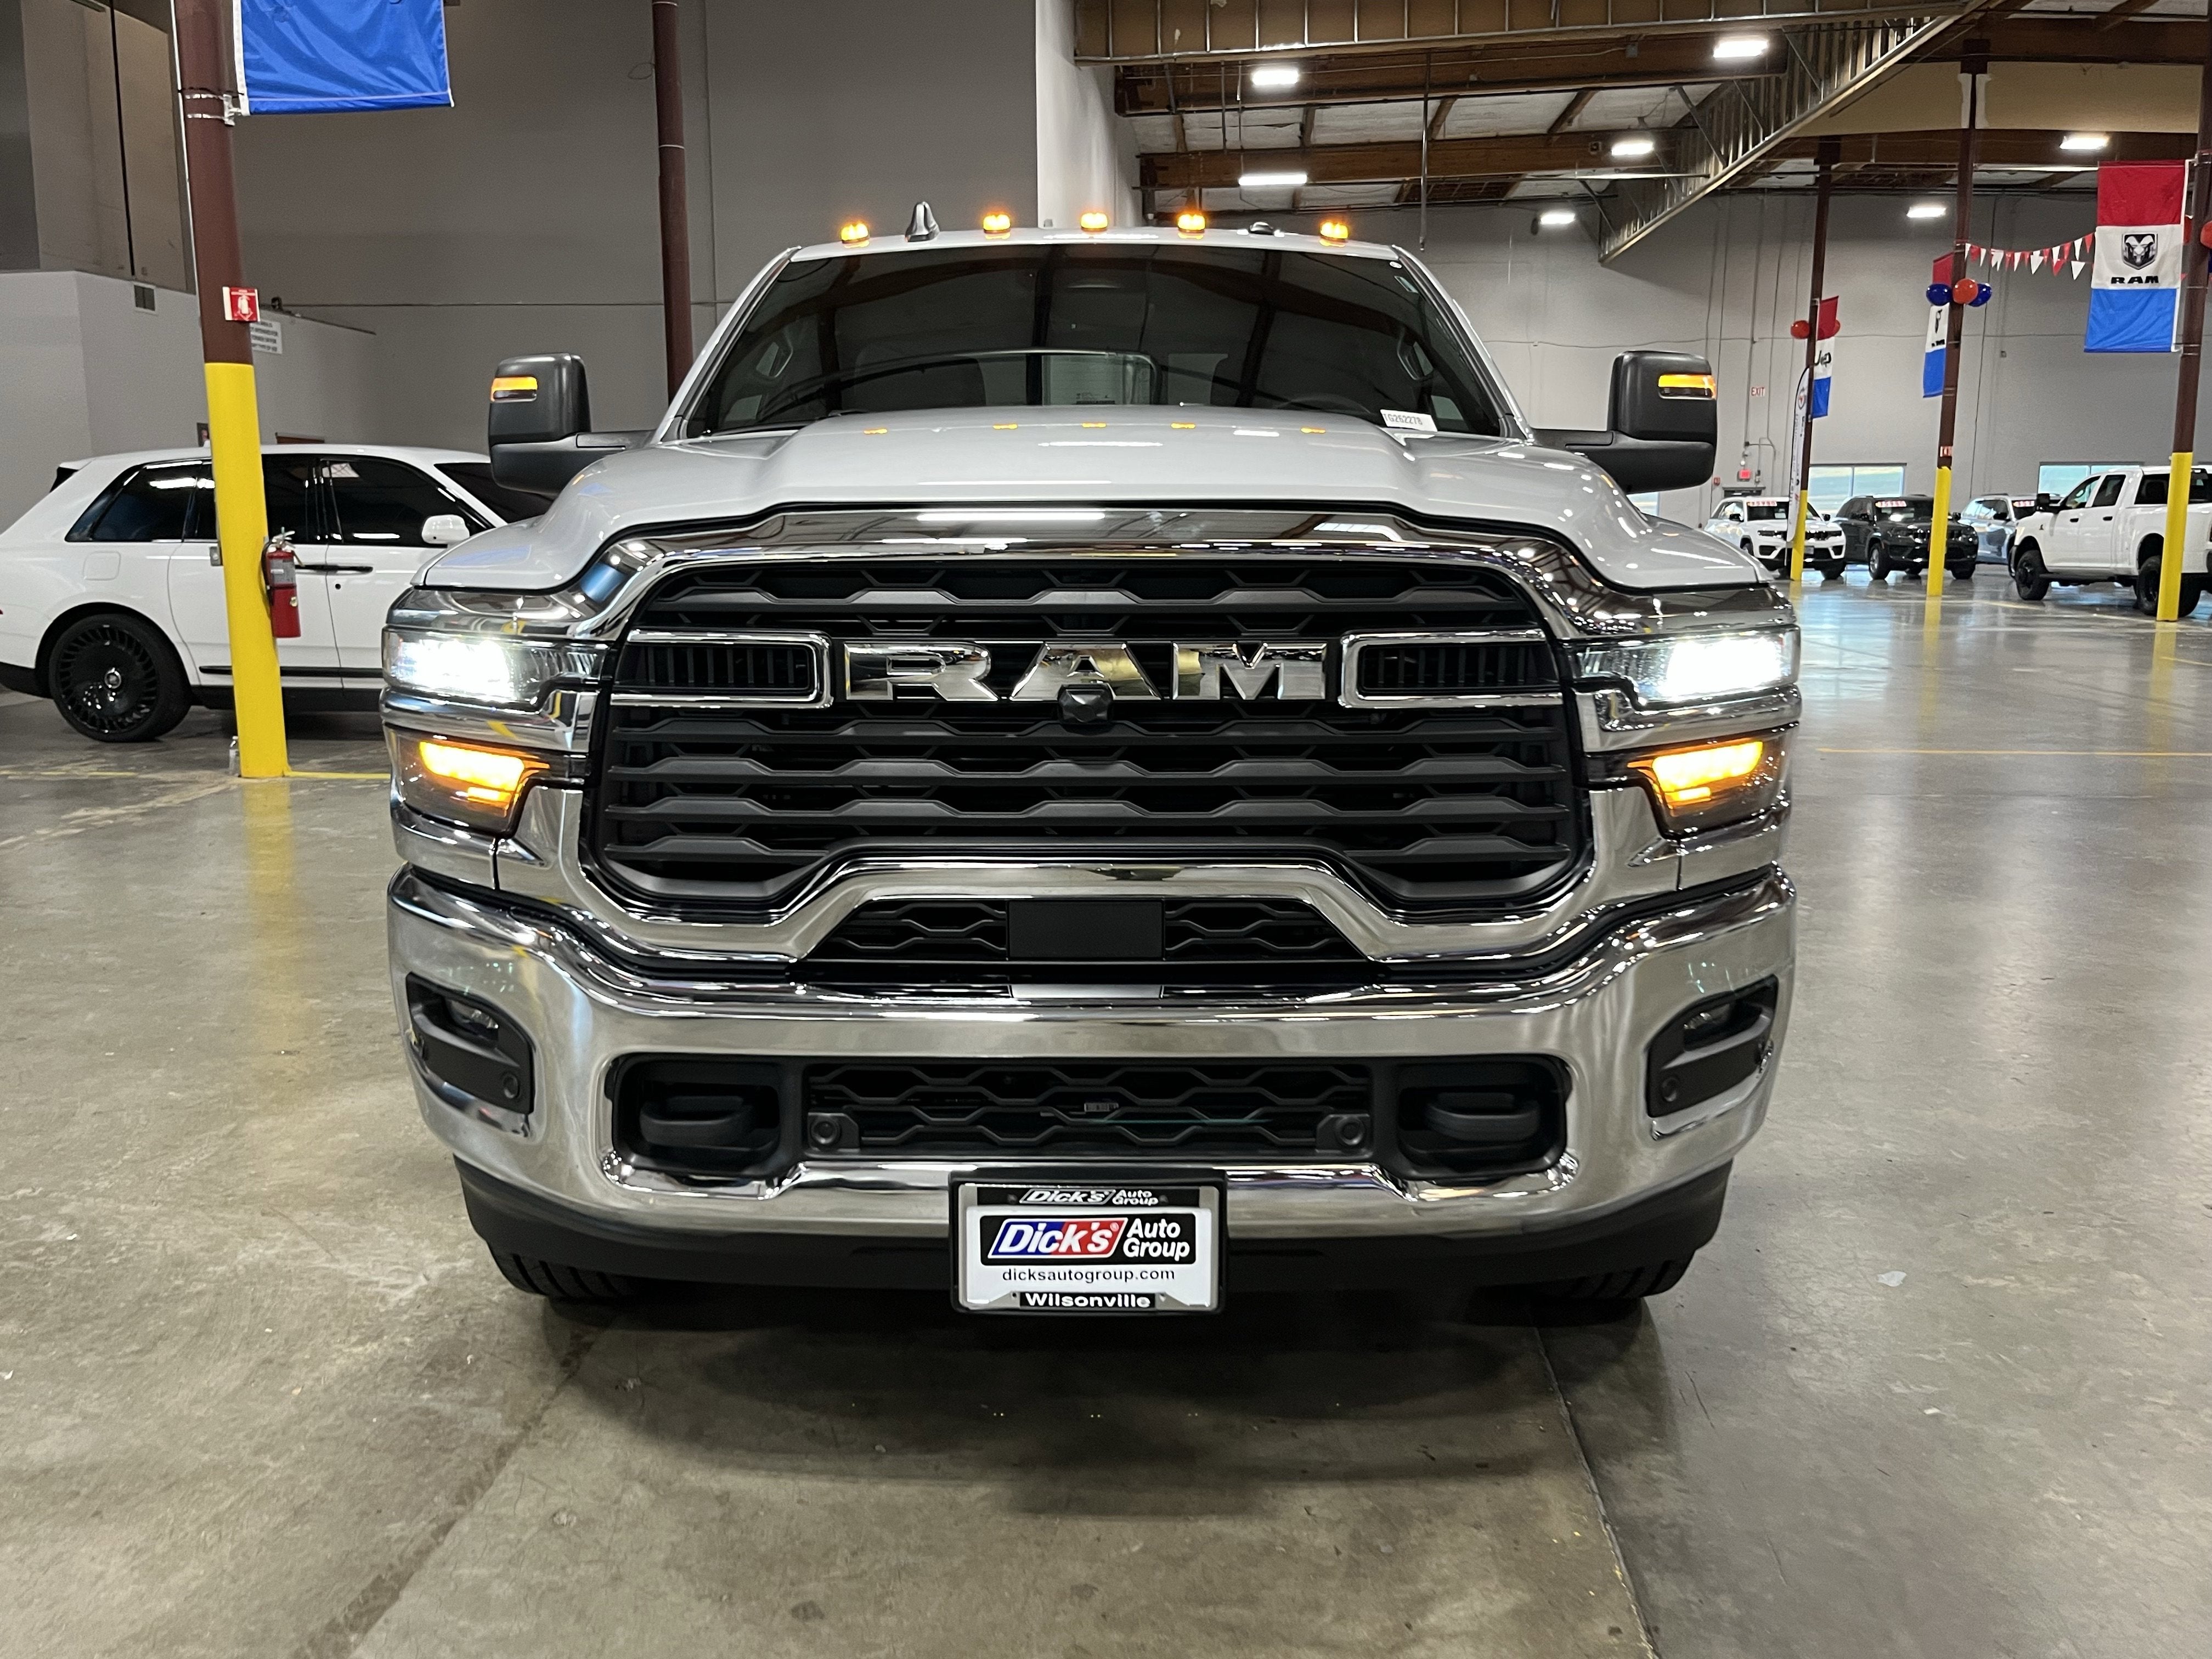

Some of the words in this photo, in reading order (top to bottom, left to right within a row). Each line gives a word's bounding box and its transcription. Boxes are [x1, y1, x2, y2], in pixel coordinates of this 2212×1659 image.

[2111, 275, 2159, 284] RAM
[1751, 386, 1765, 396] EXIT
[843, 641, 1327, 701] RAM
[1026, 1189, 1105, 1203] Dick's
[1115, 1189, 1153, 1198] Auto
[1112, 1197, 1158, 1206] Group
[998, 1222, 1111, 1253] Dick's
[1126, 1218, 1180, 1238] Auto
[1123, 1237, 1190, 1262] Group
[1002, 1268, 1175, 1284] dicksautogroup.com
[1025, 1293, 1151, 1308] Wilsonville
